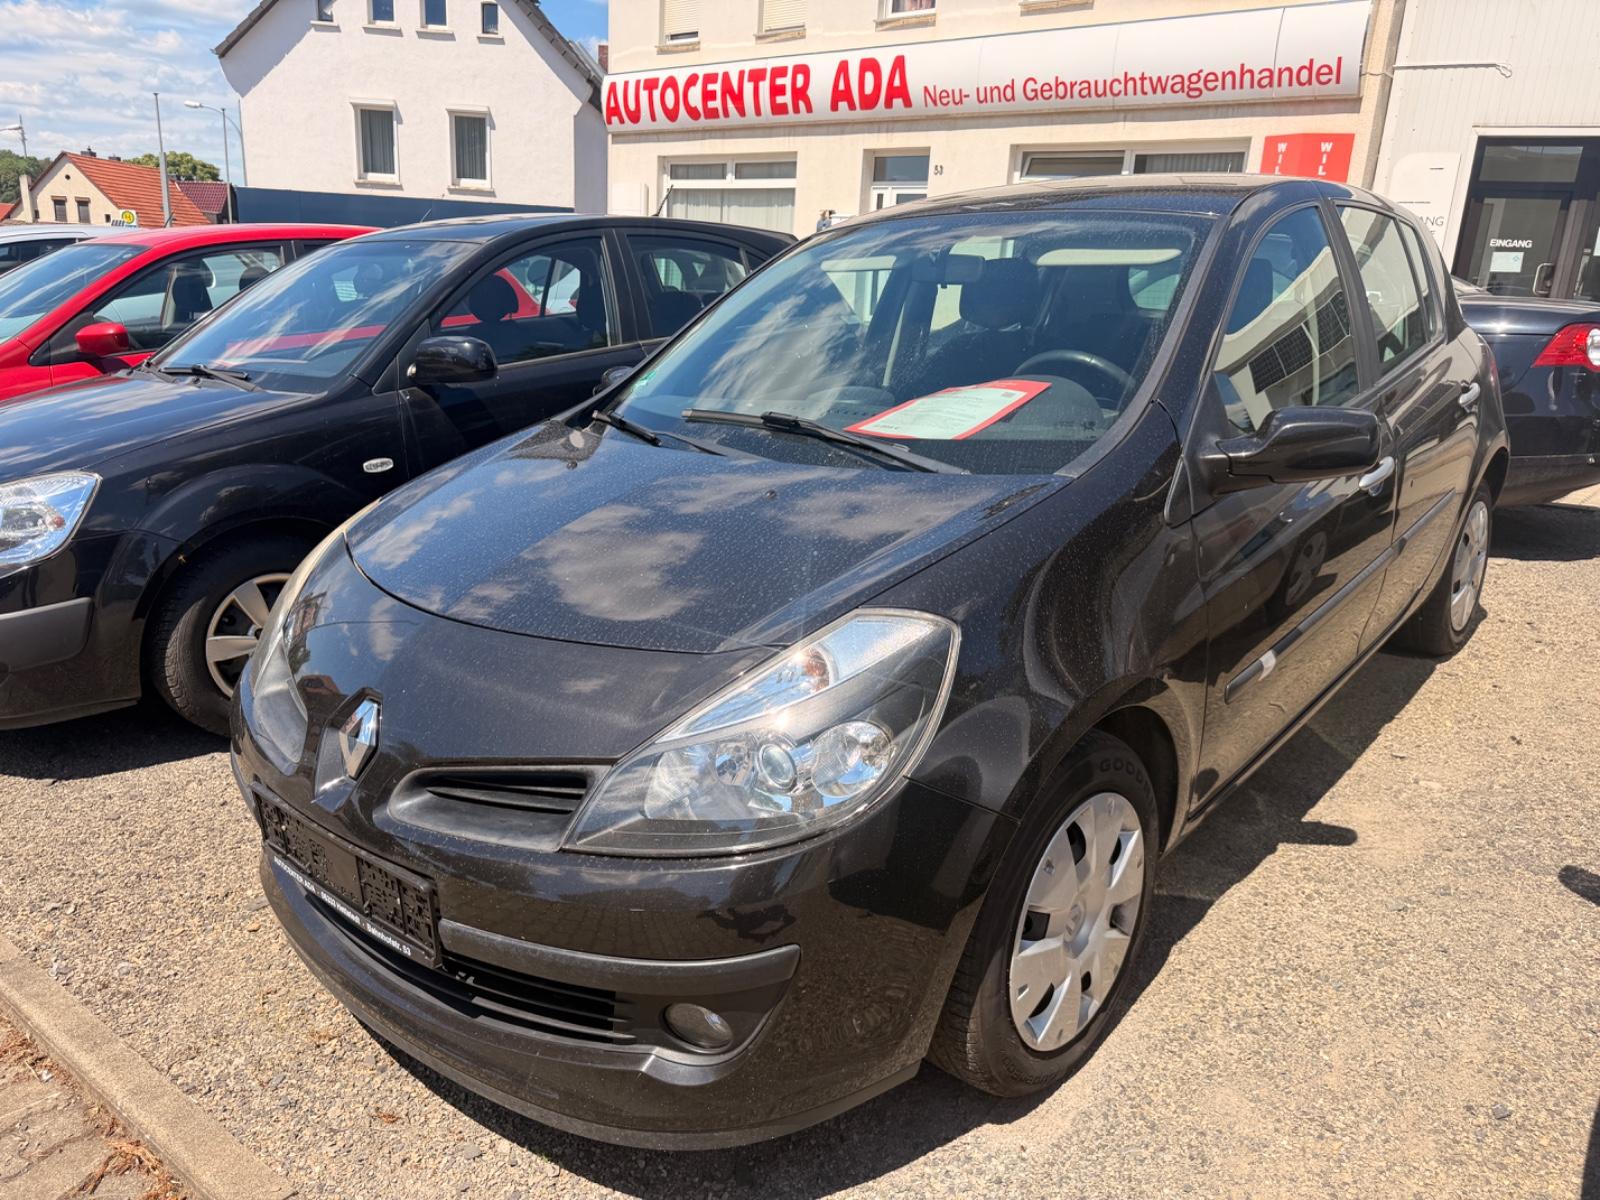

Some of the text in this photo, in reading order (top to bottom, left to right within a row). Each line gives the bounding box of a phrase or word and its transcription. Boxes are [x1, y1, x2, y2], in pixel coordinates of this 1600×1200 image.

[605, 55, 912, 126] AUTOCENTER ADA
[923, 56, 1343, 108] Neu- und Gebrauchtwagenhandel
[1489, 238, 1533, 249] EINGANG
